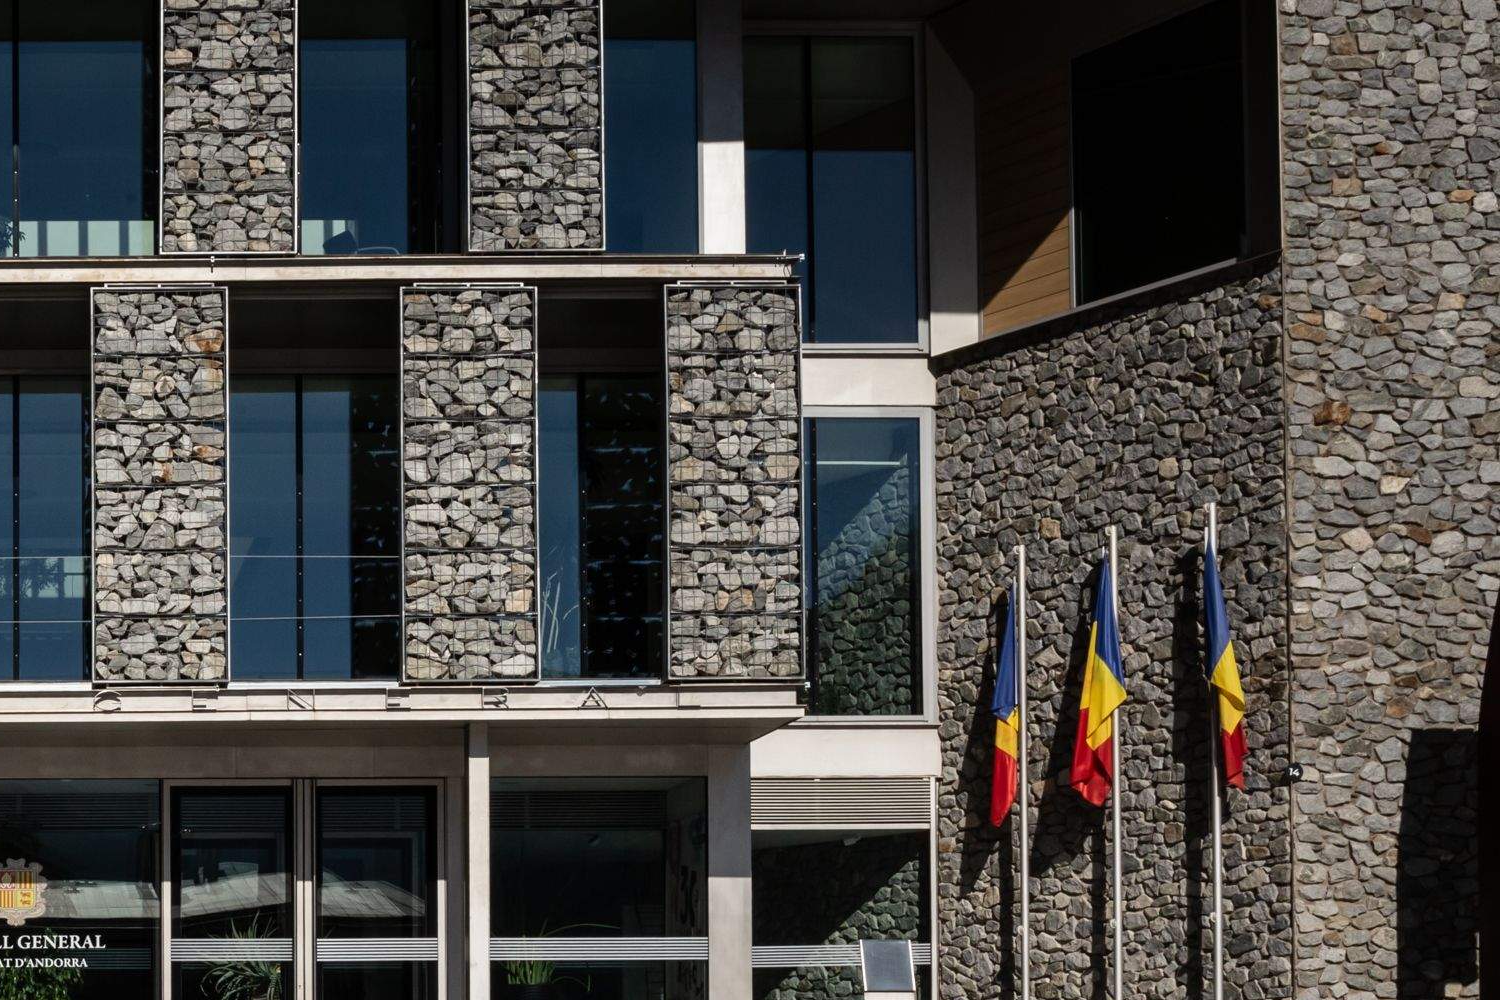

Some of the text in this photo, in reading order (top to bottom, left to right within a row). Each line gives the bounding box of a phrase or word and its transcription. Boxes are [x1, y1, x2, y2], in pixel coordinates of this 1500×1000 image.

[1289, 767, 1300, 776] 14
[17, 934, 106, 949] GENERAL
[14, 957, 88, 968] D'ANDORRA
